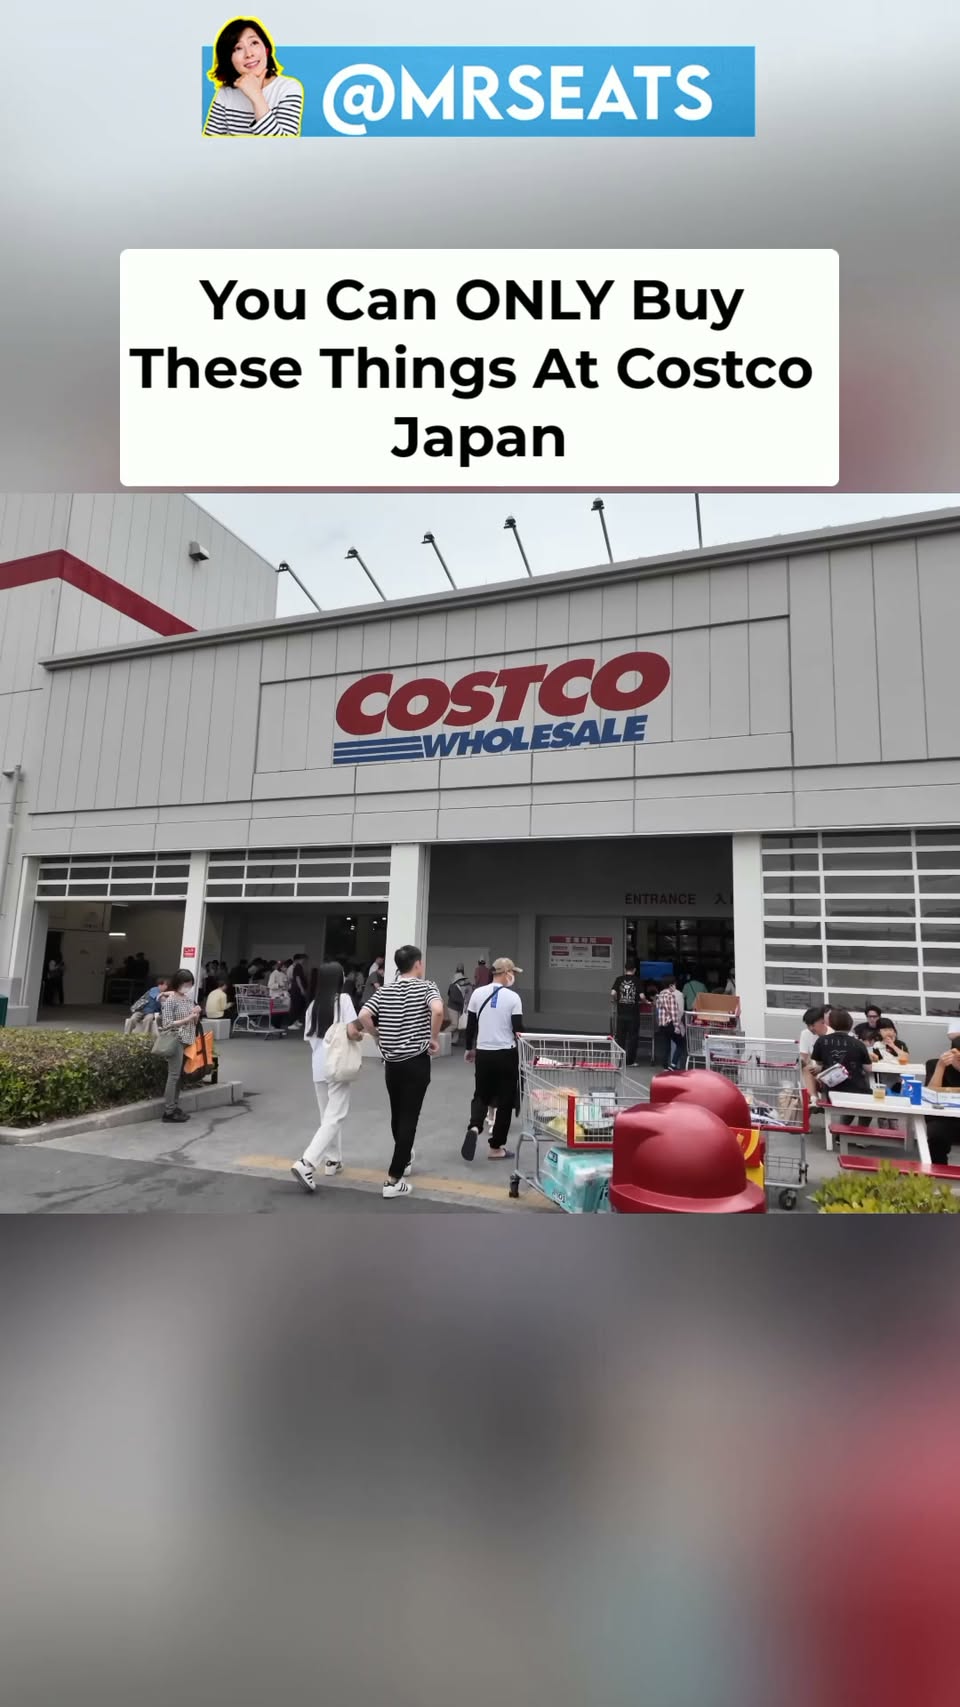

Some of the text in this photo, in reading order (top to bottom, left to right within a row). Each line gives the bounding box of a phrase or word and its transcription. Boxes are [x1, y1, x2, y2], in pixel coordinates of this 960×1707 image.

[336, 651, 670, 735] COSTCO
[422, 715, 648, 758] WHOLESALE
[624, 893, 697, 905] ENTRANCE
